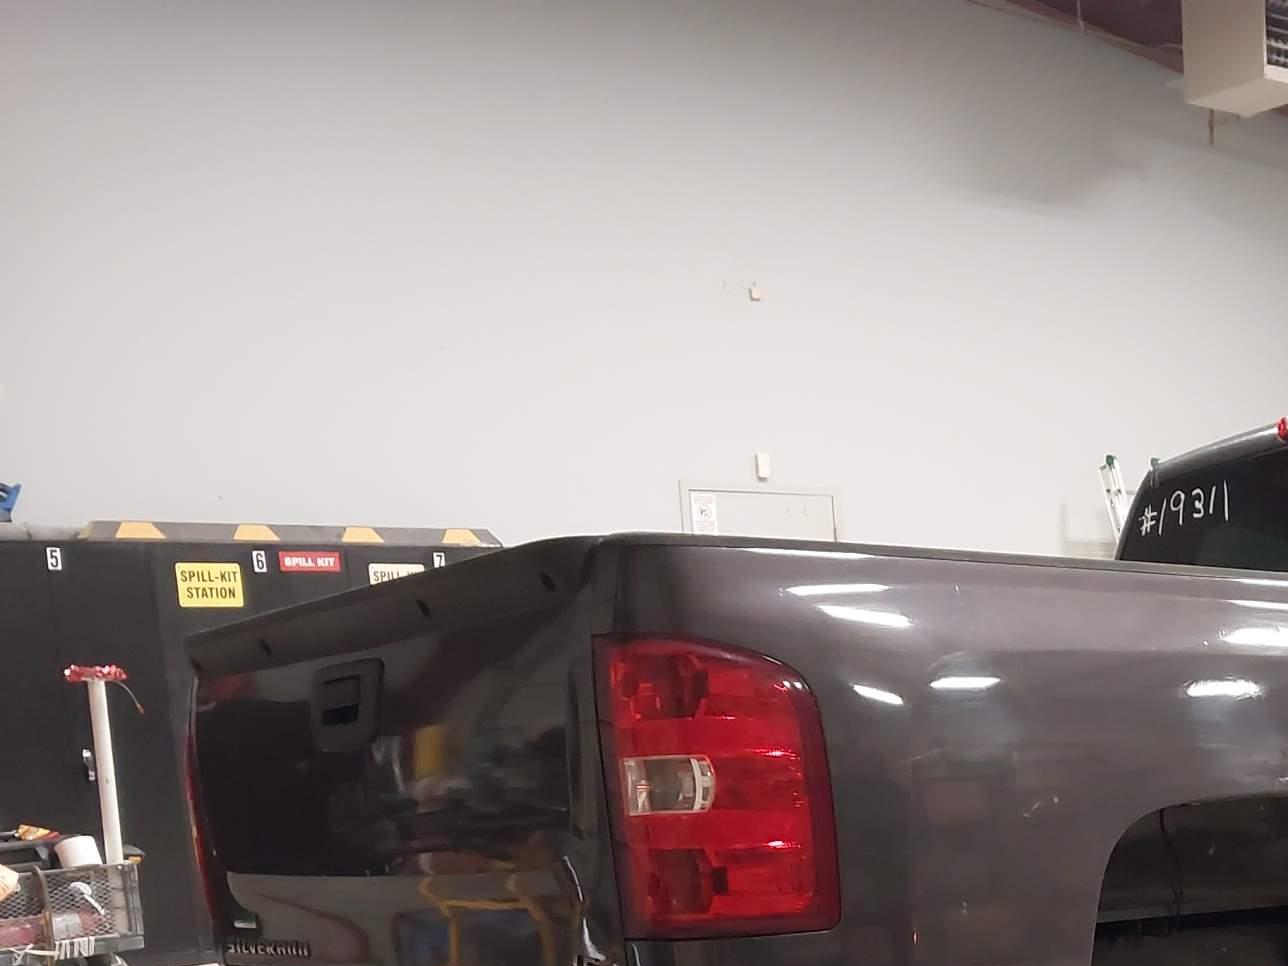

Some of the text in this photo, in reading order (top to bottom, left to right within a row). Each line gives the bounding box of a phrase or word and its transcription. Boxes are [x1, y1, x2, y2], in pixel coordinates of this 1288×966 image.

[1138, 479, 1230, 537] #19311
[50, 549, 59, 568] 5
[255, 552, 265, 570] 6
[283, 556, 336, 567] SPILL KIT
[435, 554, 443, 568] 7
[180, 570, 238, 583] SPILL-KIT
[186, 586, 236, 599] STATION
